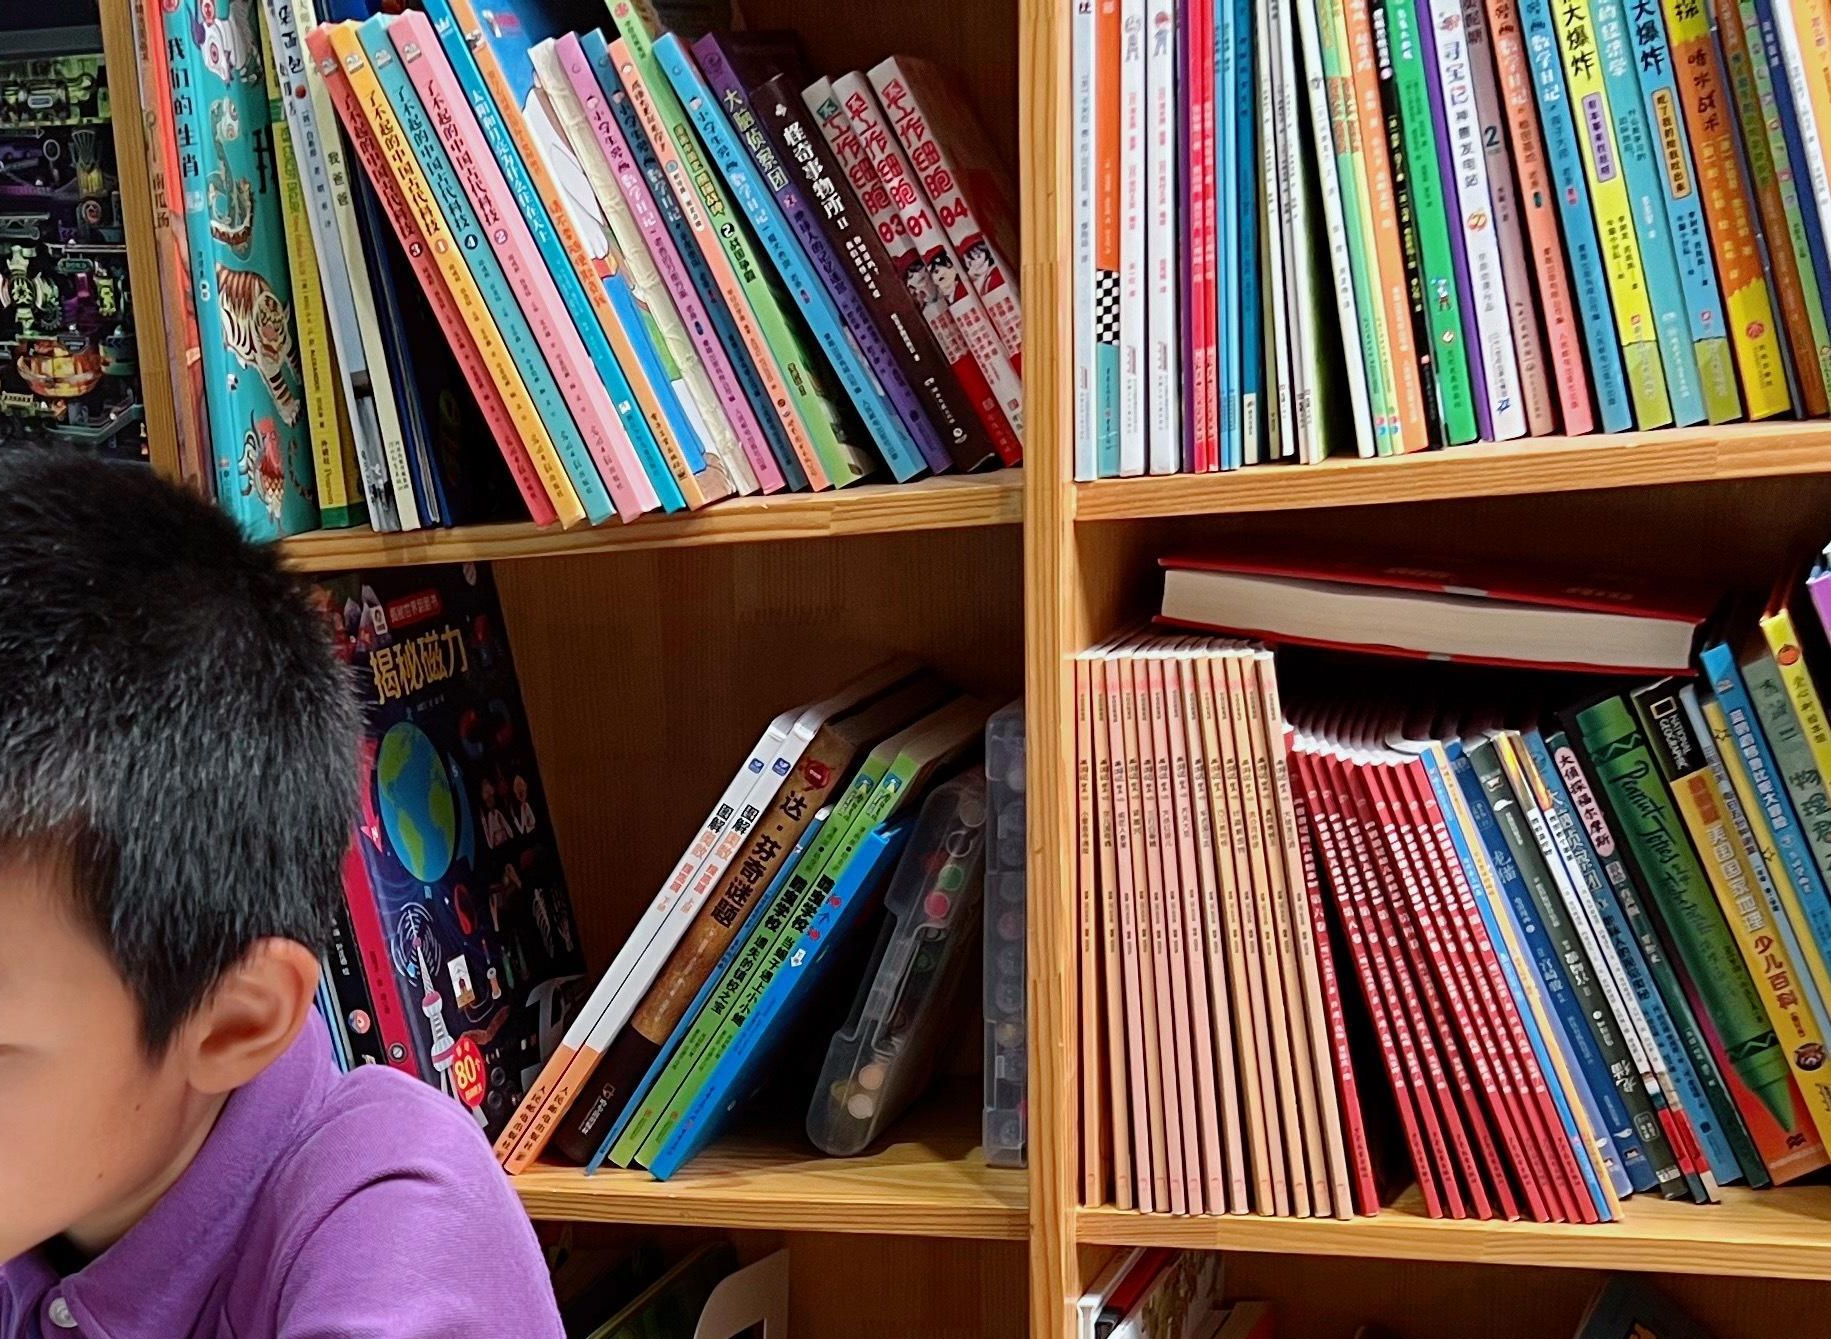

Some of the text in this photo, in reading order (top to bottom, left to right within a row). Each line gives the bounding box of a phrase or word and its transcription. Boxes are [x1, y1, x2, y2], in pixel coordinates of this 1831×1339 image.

[1562, 4, 1596, 81] 大爆炸
[1632, 1, 1665, 75] 大爆炸
[168, 37, 199, 178] 我们的生肖
[1483, 125, 1500, 148] 2
[328, 151, 350, 207] 我爸爸
[371, 90, 441, 237] 了不起的中国古代科技
[399, 85, 470, 232] 了不起的中国古代科技
[428, 79, 500, 227] 了不起的中国古代科技
[782, 119, 846, 219] 怪奇事物所
[878, 217, 906, 244] 03
[906, 209, 933, 238] 01
[939, 197, 969, 229] 04
[369, 624, 469, 705] 揭秘磁力
[1659, 718, 1689, 772] GEOGRAPHIC
[1668, 711, 1692, 756] NATIONAL
[1557, 752, 1611, 848] 大侦探福尔摩斯
[1705, 823, 1766, 934] 美国国家地理
[1754, 934, 1802, 1011] 少儿百科
